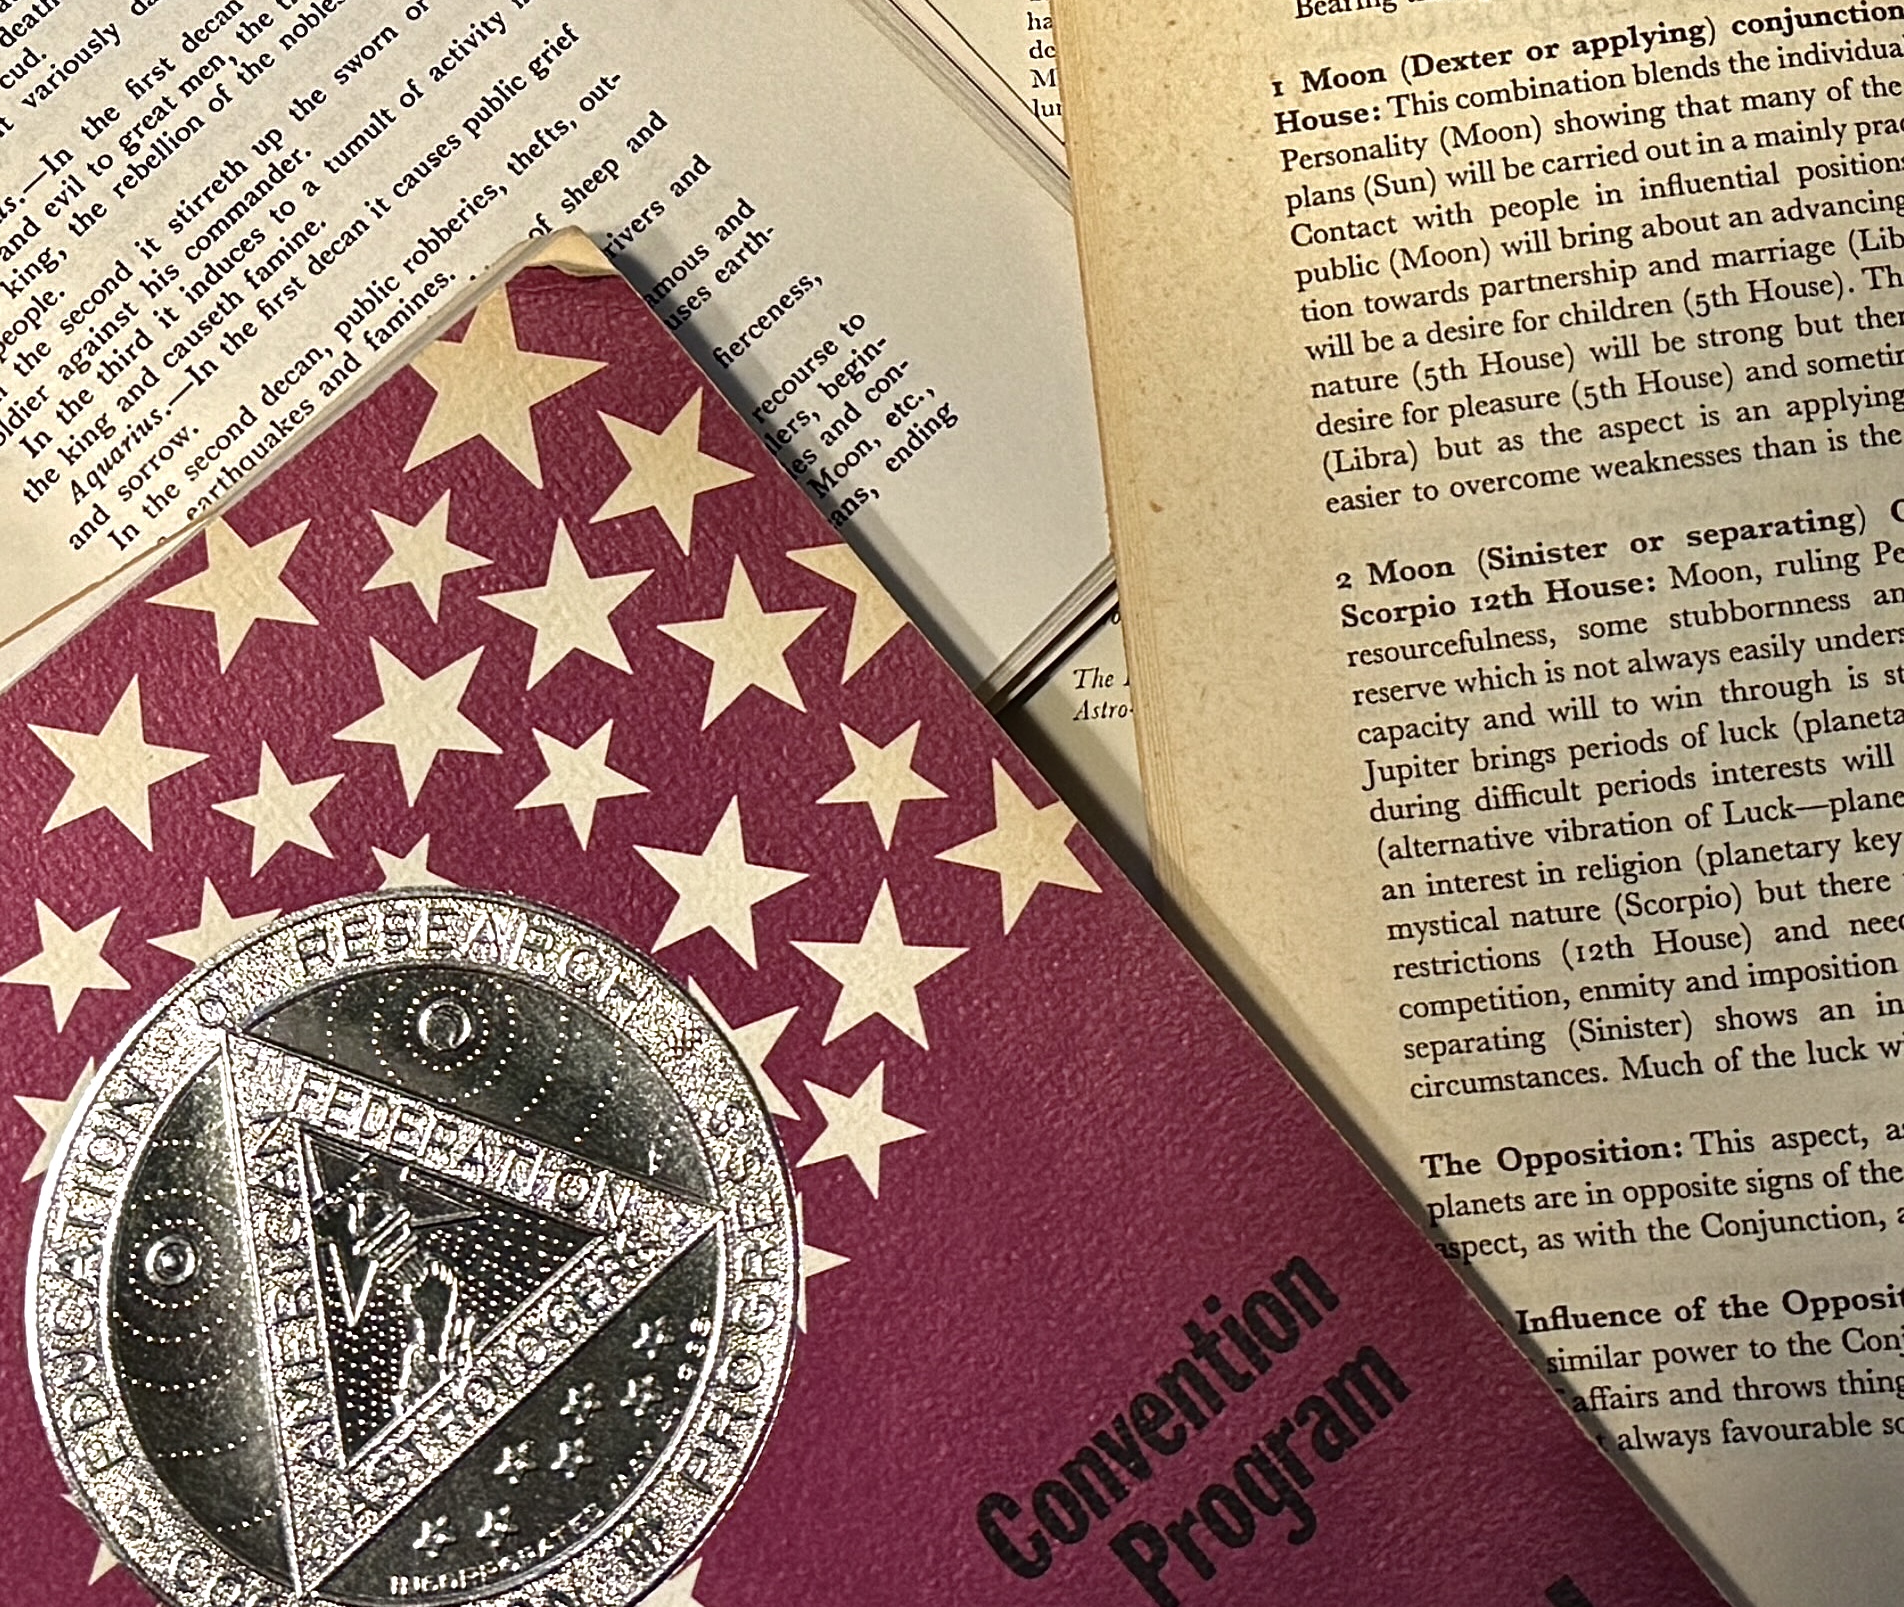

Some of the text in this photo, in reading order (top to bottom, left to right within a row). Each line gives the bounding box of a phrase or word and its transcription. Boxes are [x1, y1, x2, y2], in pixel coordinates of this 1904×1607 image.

[1300, 66, 1387, 94] Moon
[1401, 49, 1513, 86] (Dexter
[1526, 42, 1560, 61] or
[1571, 15, 1716, 61] applying)
[294, 902, 653, 1022] RESEARCH
[46, 1071, 164, 1473] EDUCATION
[252, 1110, 337, 1470] AMERICAN
[290, 1078, 633, 1222] FEDERATION
[1419, 1132, 1692, 1179] The Opposition:
[347, 1226, 657, 1524] ASTROLOGERS
[674, 1101, 781, 1495] PROGRESS
[975, 1253, 1341, 1580] Convention
[1108, 1344, 1412, 1607] Program
